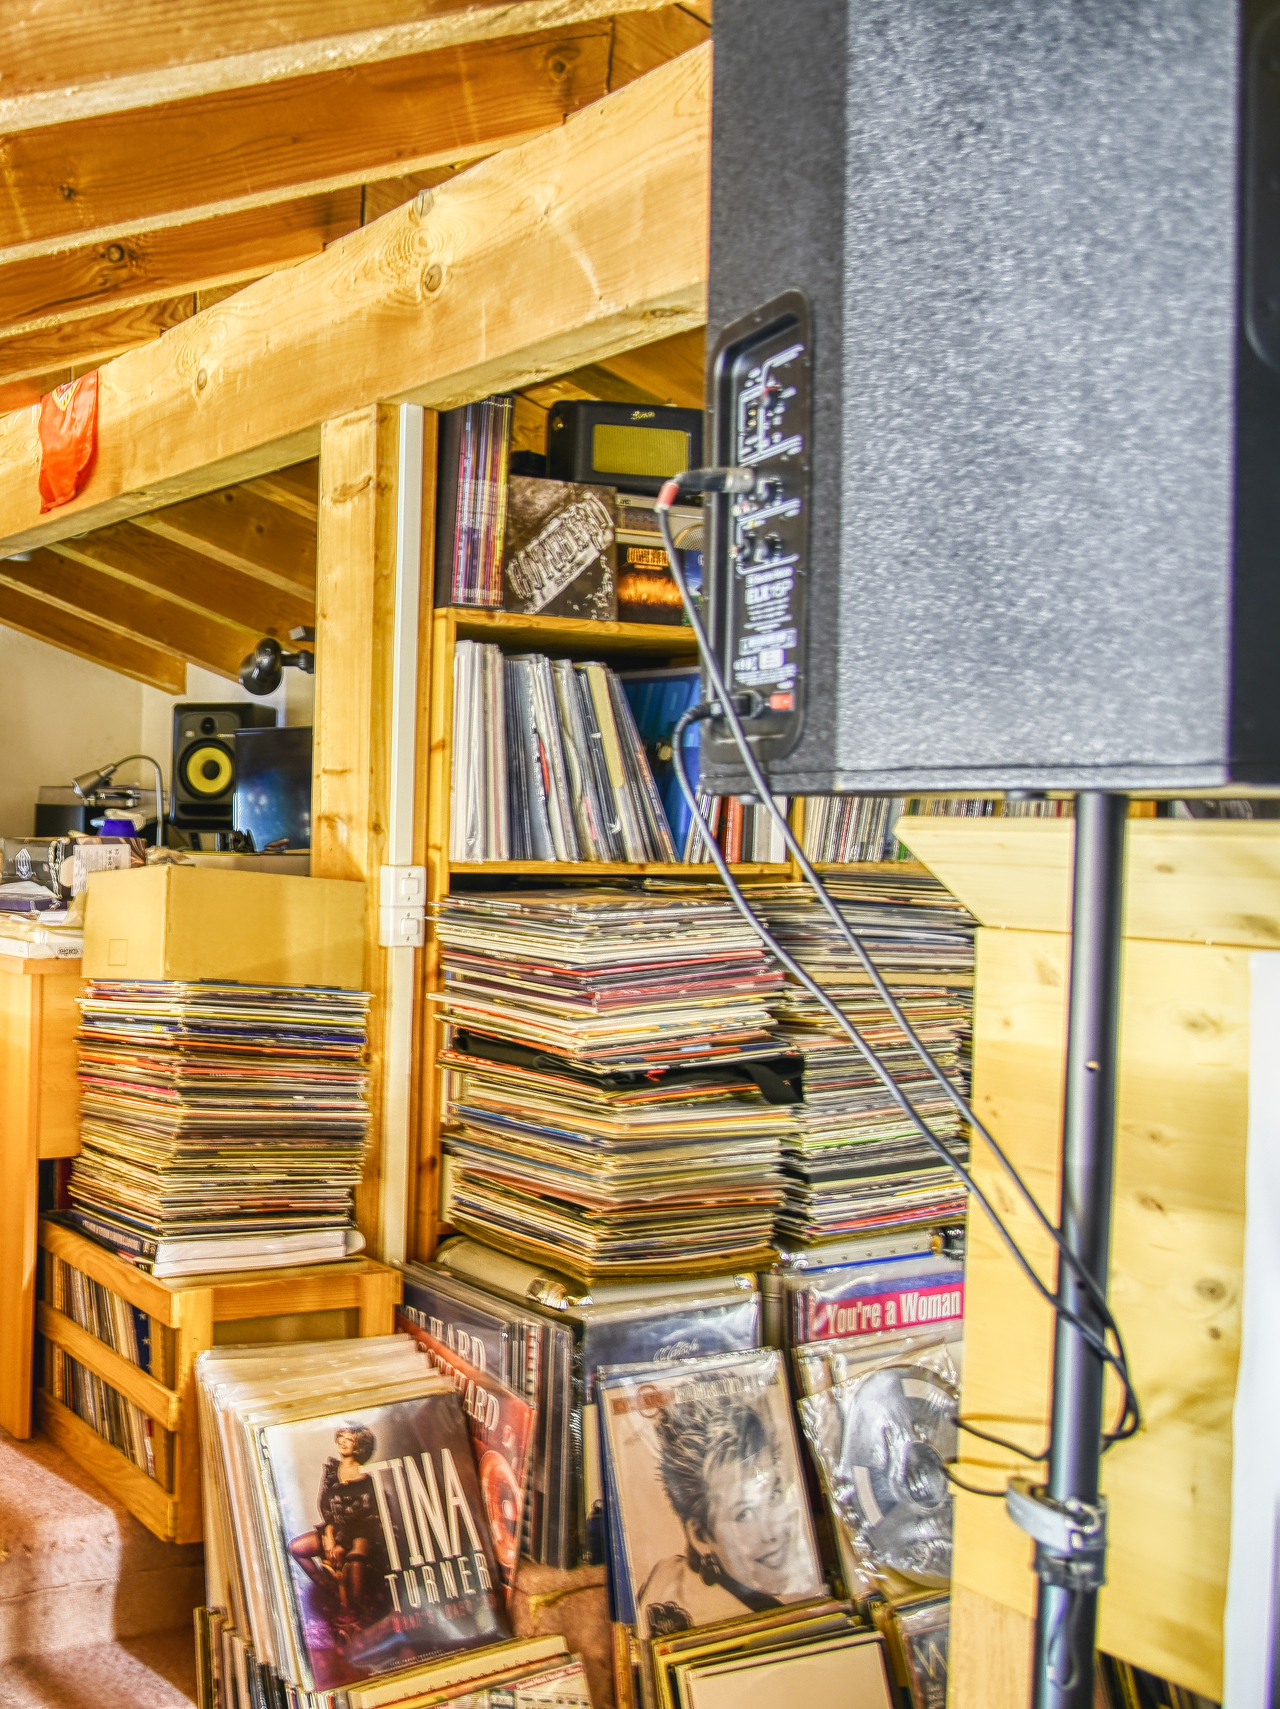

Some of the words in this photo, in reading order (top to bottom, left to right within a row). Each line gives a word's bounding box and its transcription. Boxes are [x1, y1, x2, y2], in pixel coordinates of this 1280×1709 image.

[826, 1302, 882, 1334] You're
[885, 1300, 898, 1326] a
[899, 1291, 962, 1324] Woman
[359, 1448, 483, 1572] TINA
[384, 1552, 493, 1613] TURNER
